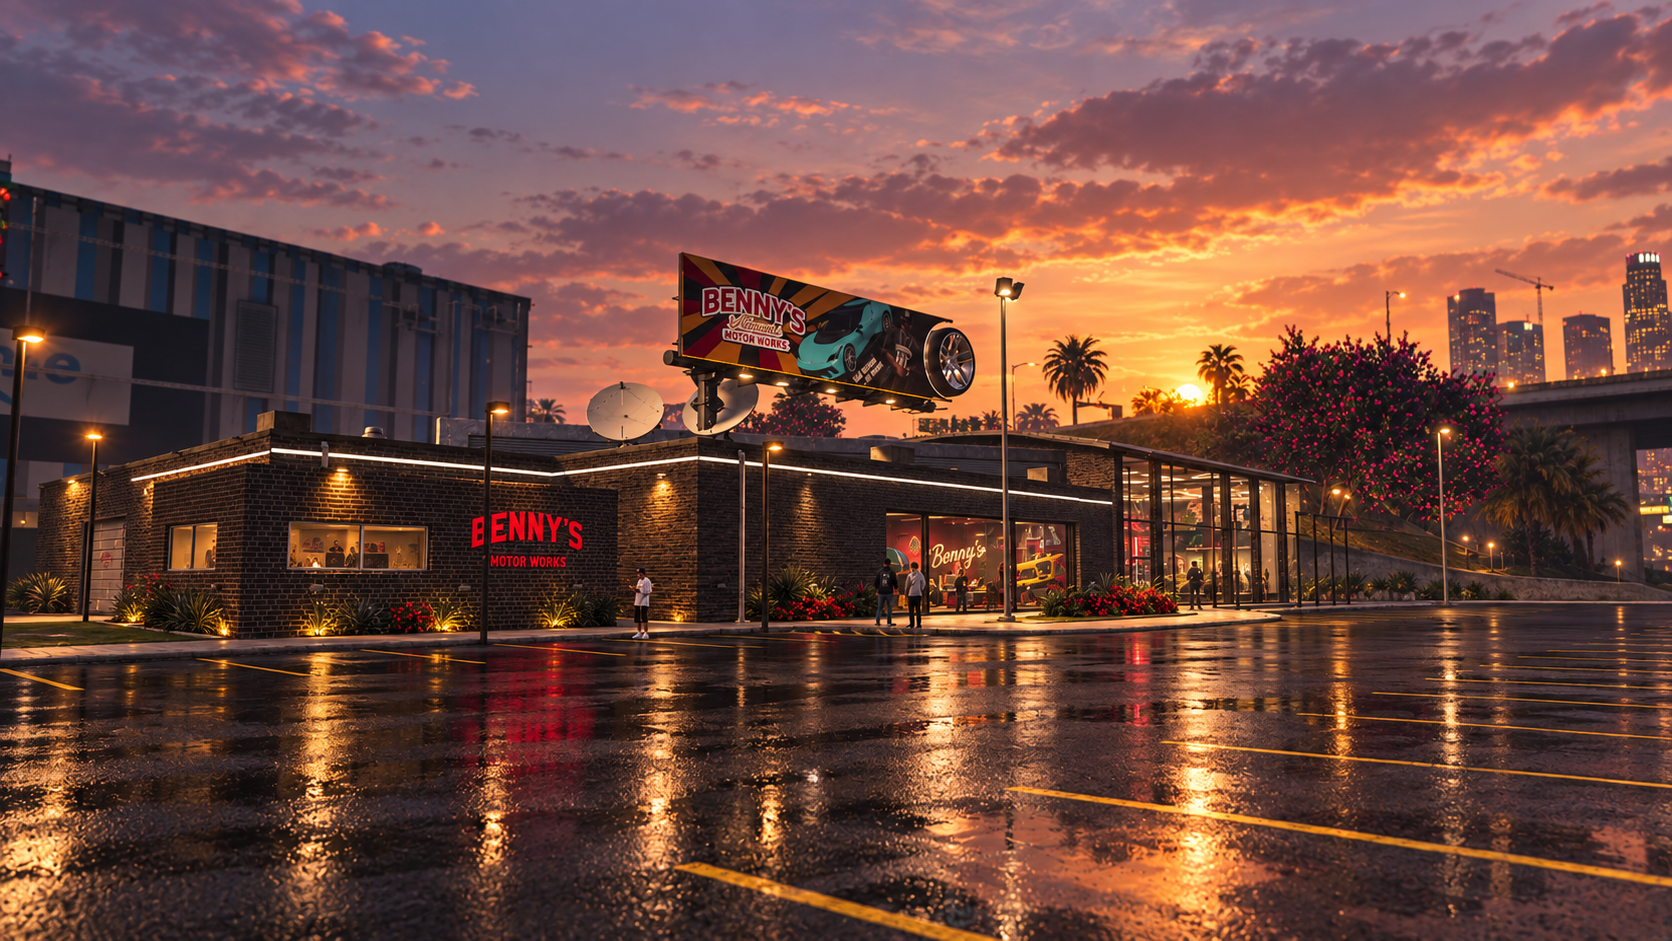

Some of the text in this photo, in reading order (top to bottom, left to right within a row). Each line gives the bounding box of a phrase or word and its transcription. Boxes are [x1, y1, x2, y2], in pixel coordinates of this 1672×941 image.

[702, 287, 806, 335] BENNY'S
[724, 331, 787, 350] MOTOR WORKS
[471, 511, 583, 550] BENNY'S
[490, 555, 566, 567] MOTOR WORKS
[932, 540, 986, 569] Benny's
